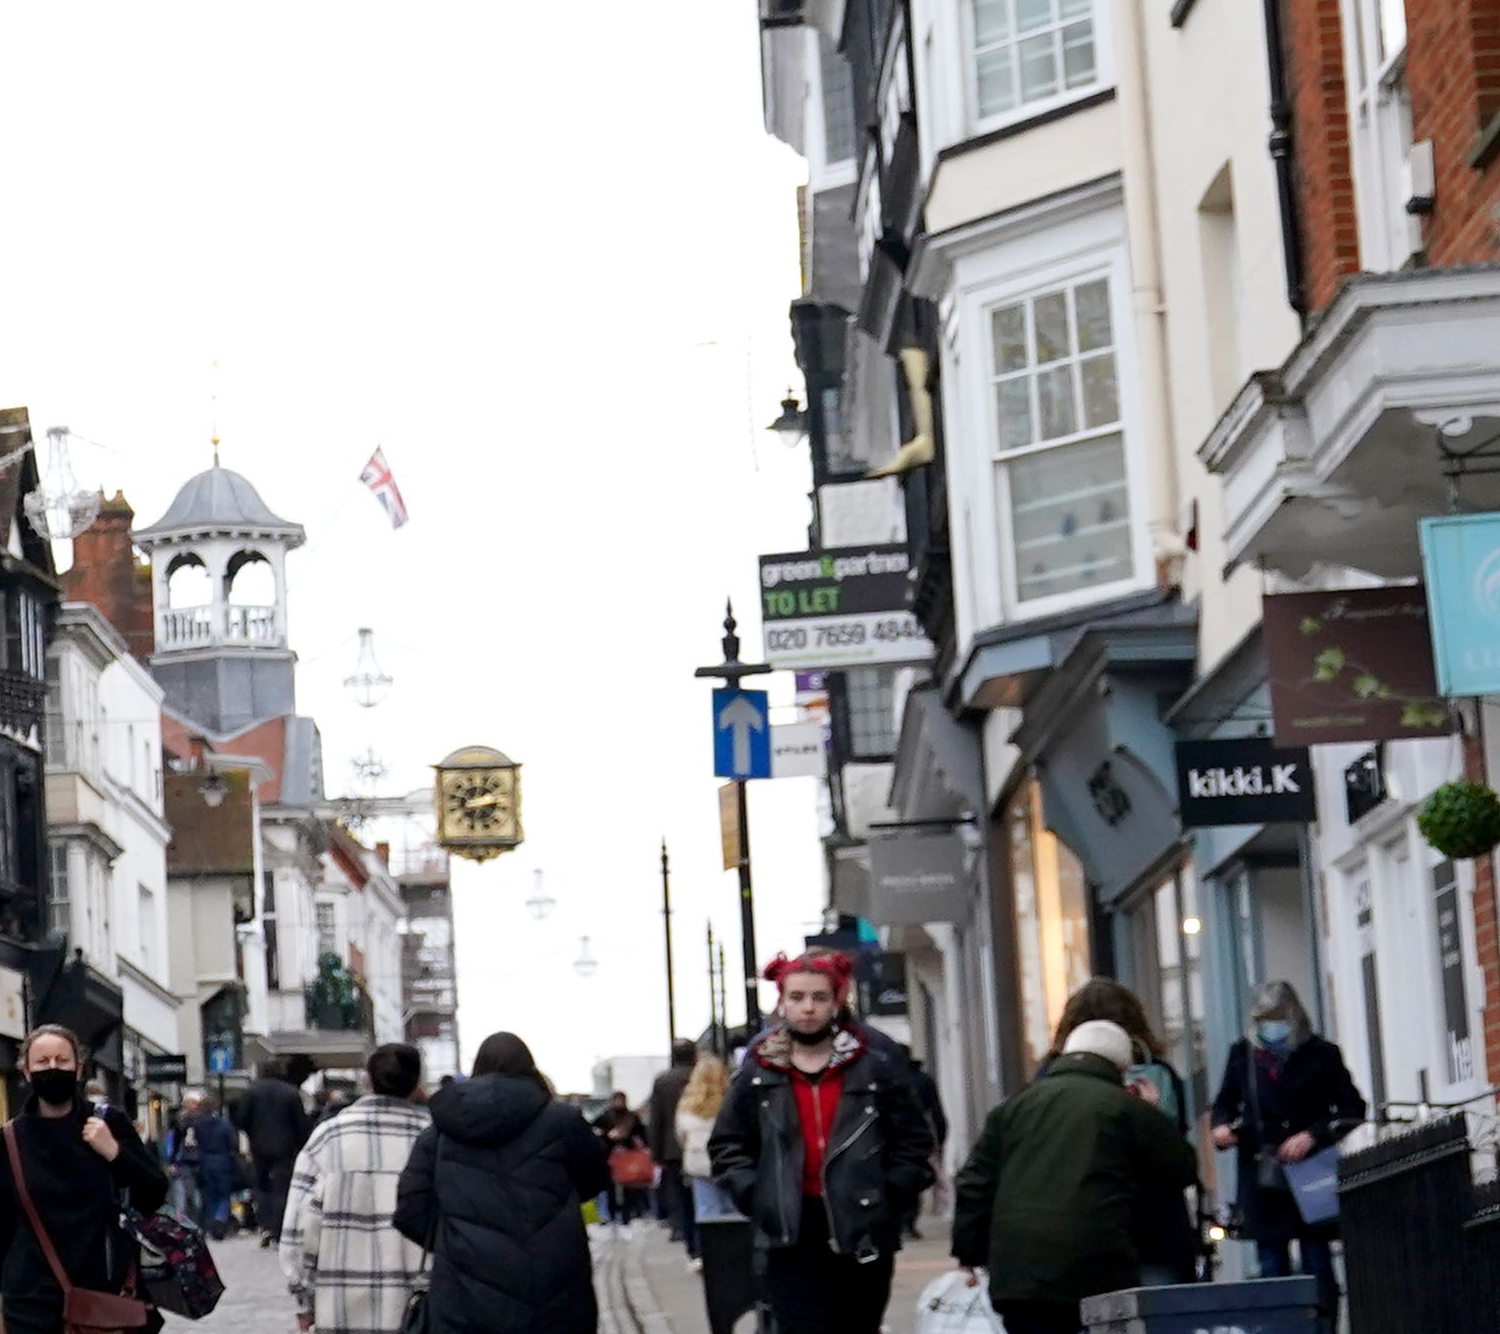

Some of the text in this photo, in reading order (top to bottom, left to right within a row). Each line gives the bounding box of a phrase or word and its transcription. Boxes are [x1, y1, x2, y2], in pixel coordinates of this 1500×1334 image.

[764, 586, 841, 616] TO LET
[767, 628, 807, 651] 020
[1188, 762, 1300, 798] kikki.K
